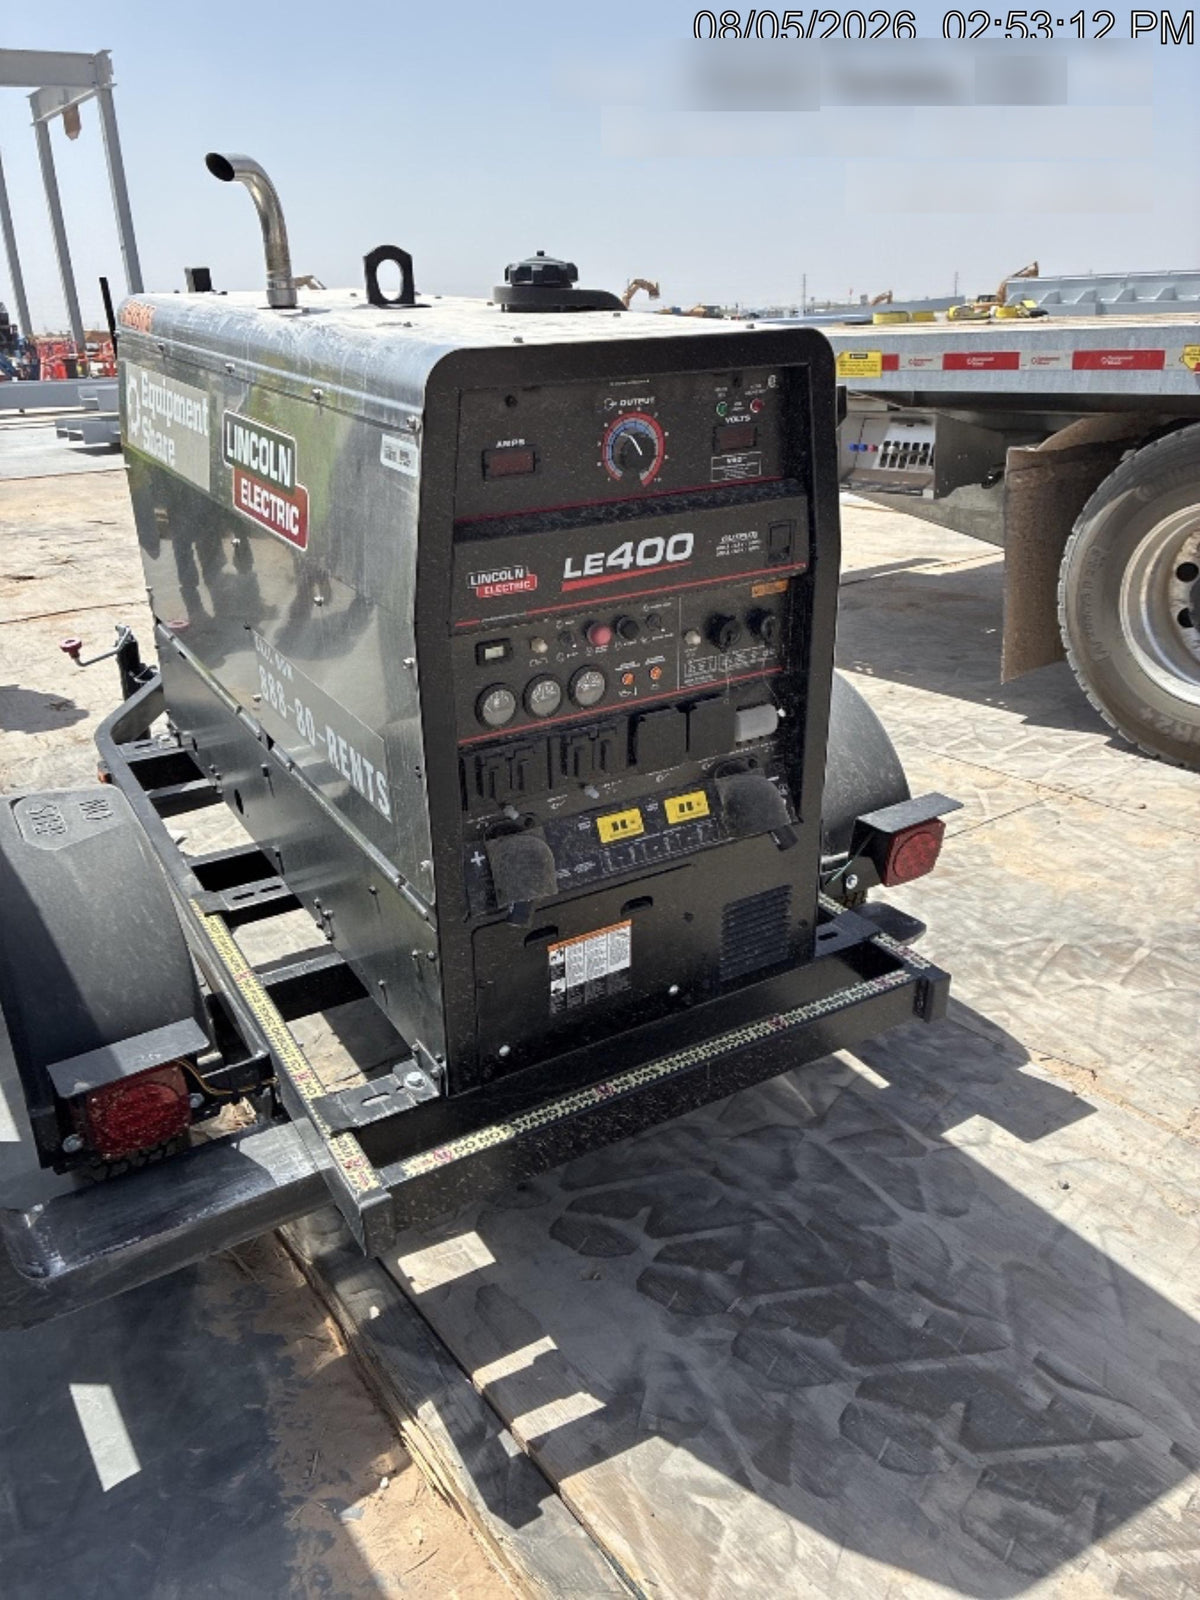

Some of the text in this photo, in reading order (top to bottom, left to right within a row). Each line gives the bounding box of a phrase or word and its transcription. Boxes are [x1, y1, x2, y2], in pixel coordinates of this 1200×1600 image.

[141, 370, 209, 438] Equipment
[620, 396, 655, 406] OUTPUT
[725, 413, 751, 424] VOLTS
[142, 414, 176, 467] Share
[226, 420, 292, 489] LINCOLN
[495, 438, 526, 449] AMPS
[240, 477, 300, 536] ELECTRIC
[563, 532, 694, 579] LE400
[470, 568, 524, 586] LINCOLN
[484, 580, 531, 595] ELECTRIC
[259, 665, 394, 824] 888-80-RENTS
[453, 1138, 475, 1156] DO
[477, 1122, 510, 1146] NOT
